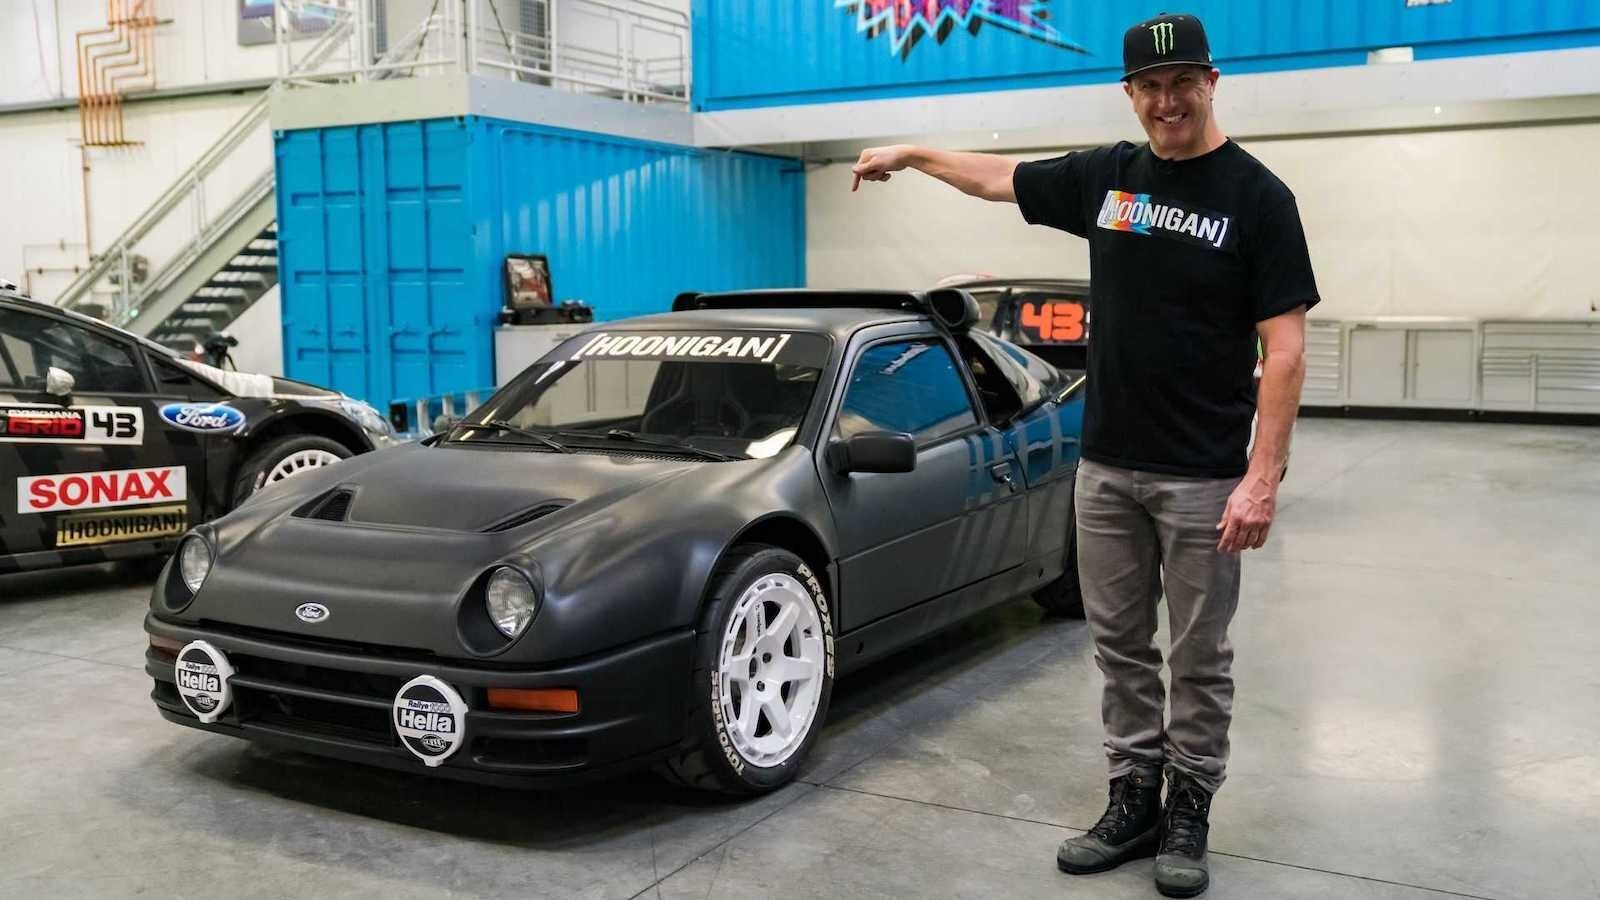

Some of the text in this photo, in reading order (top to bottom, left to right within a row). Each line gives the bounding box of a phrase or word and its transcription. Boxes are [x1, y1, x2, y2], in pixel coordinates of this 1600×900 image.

[1021, 302, 1085, 340] 43
[571, 332, 791, 363] [HOONIGAN]
[93, 411, 138, 438] 43
[29, 469, 173, 509] SONAX
[62, 508, 184, 544] [HOONIGAN]
[796, 562, 835, 681] PROXES
[180, 669, 219, 692] Hella
[400, 708, 452, 733] Hella
[408, 700, 429, 710] Rallye
